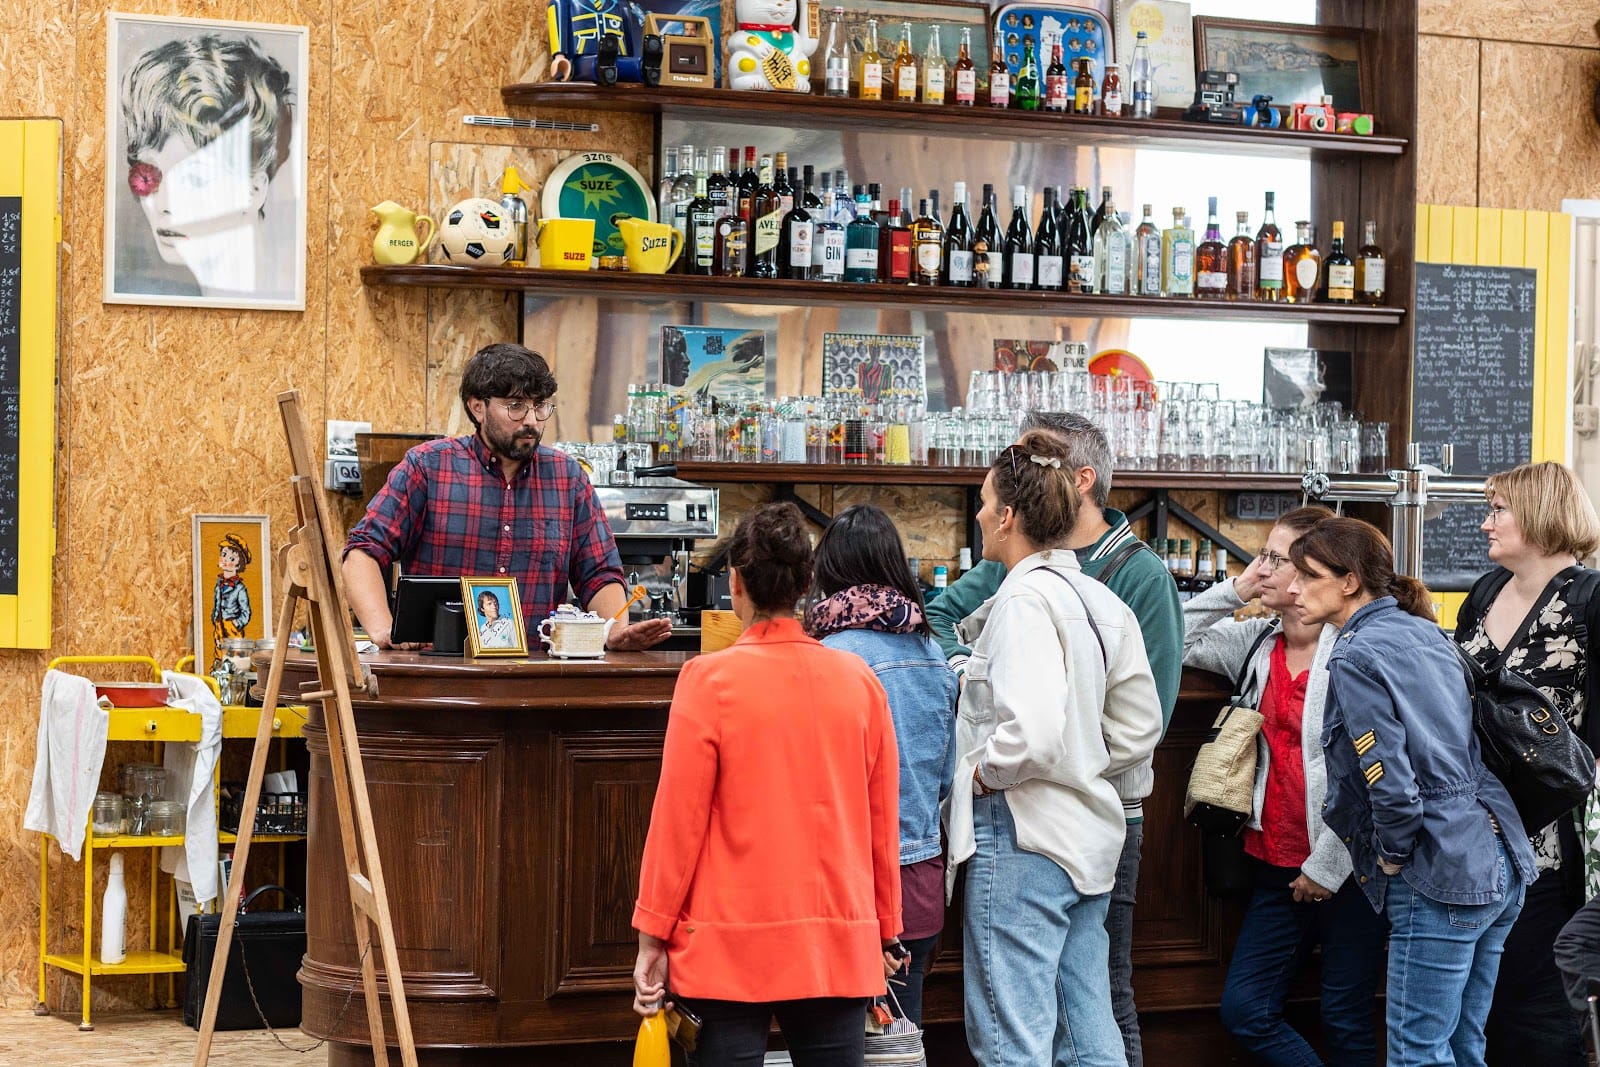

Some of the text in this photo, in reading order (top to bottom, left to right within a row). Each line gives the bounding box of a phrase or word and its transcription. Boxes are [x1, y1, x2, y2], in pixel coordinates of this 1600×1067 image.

[583, 153, 612, 162] SUZE
[580, 180, 614, 191] SUZE
[389, 239, 414, 247] BERGER
[826, 247, 841, 260] GIN
[340, 466, 360, 479] Q6
